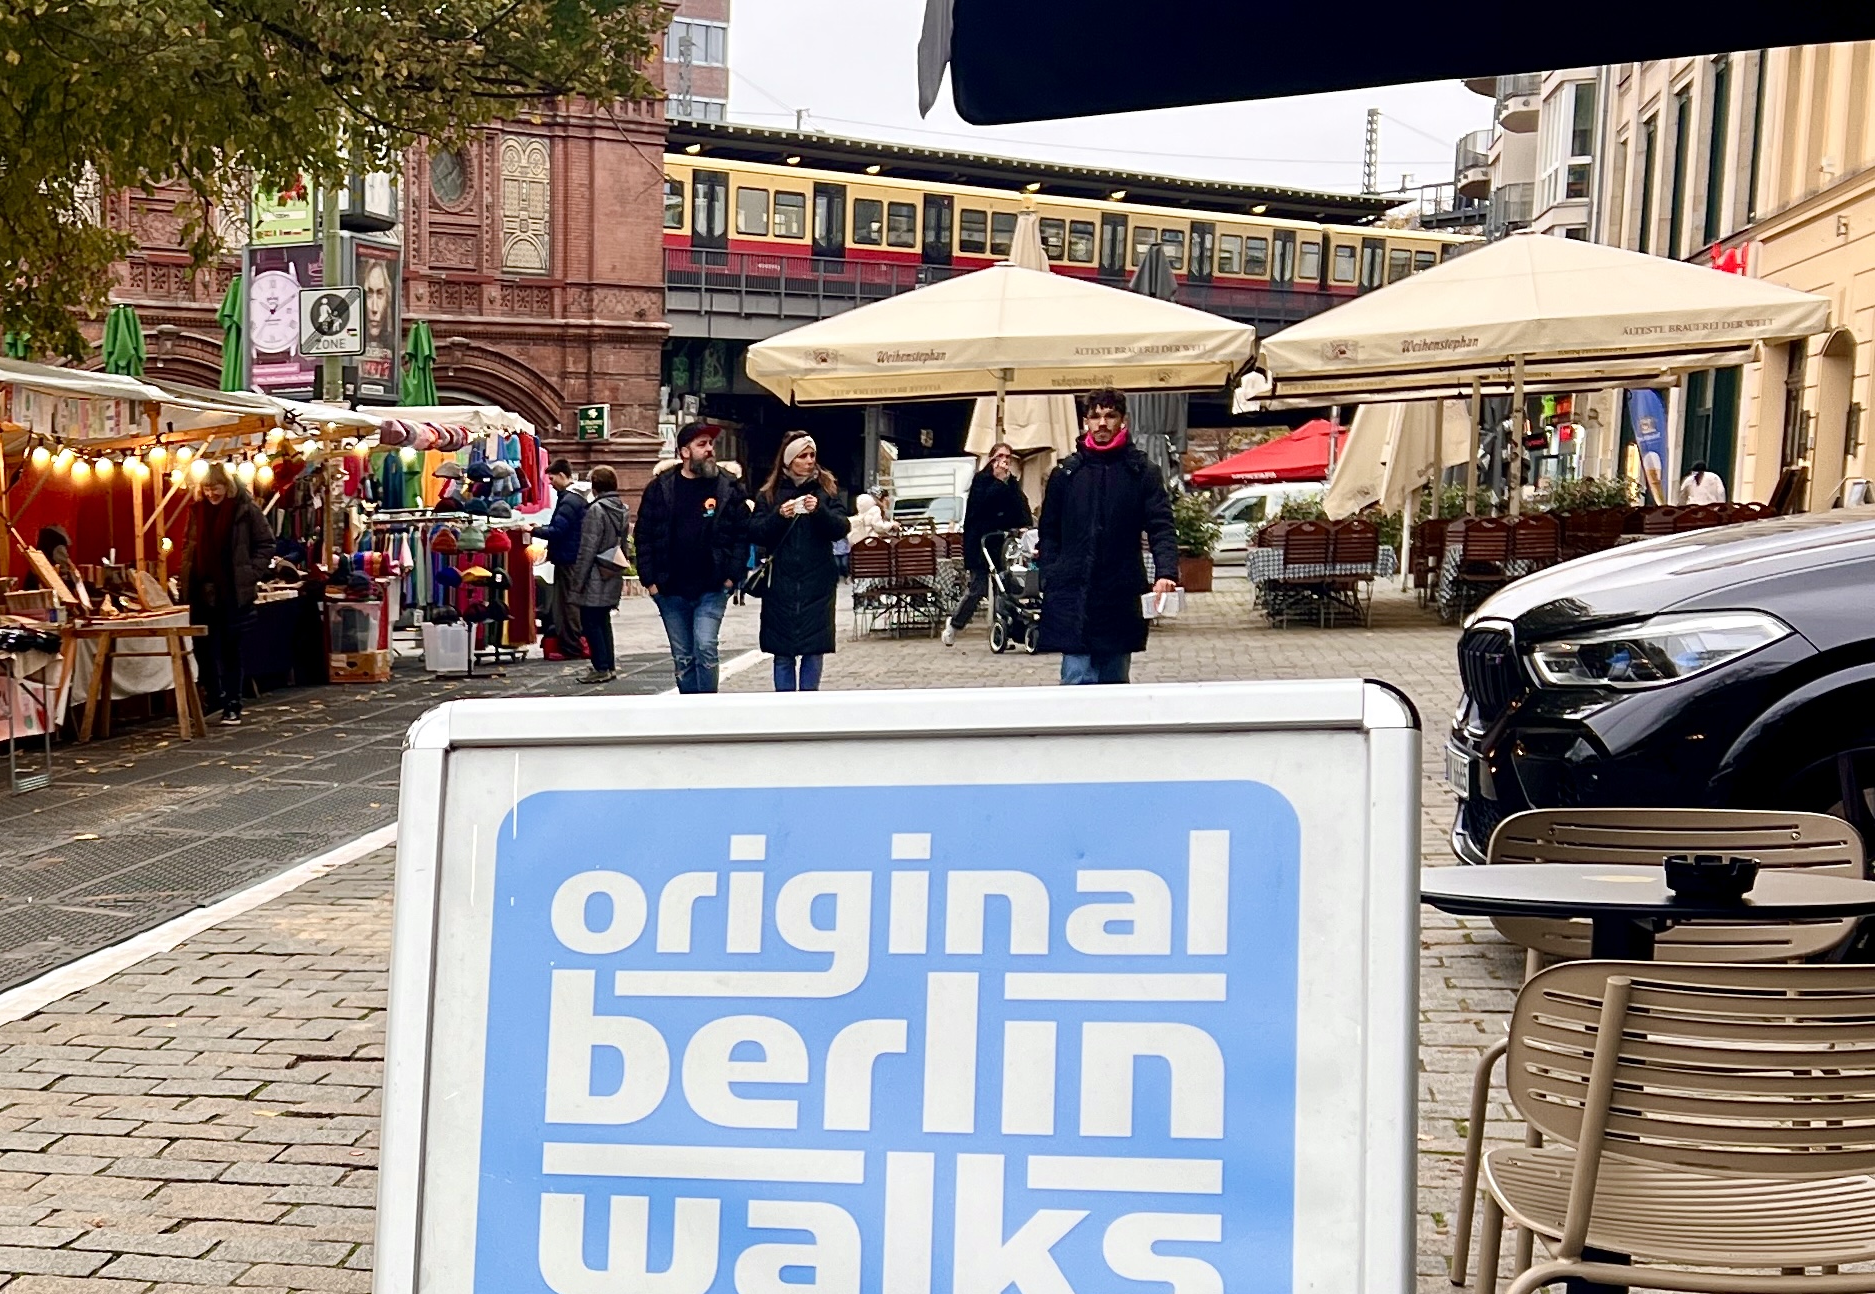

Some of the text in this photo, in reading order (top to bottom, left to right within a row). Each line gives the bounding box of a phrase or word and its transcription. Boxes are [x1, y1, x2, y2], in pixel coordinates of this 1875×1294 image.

[1722, 319, 1743, 330] DER
[315, 338, 346, 350] ZONE
[1400, 335, 1479, 353] Weihenstephan
[876, 348, 947, 364] Weihenstephan
[550, 829, 1230, 998] original
[544, 968, 1226, 1139] berlin
